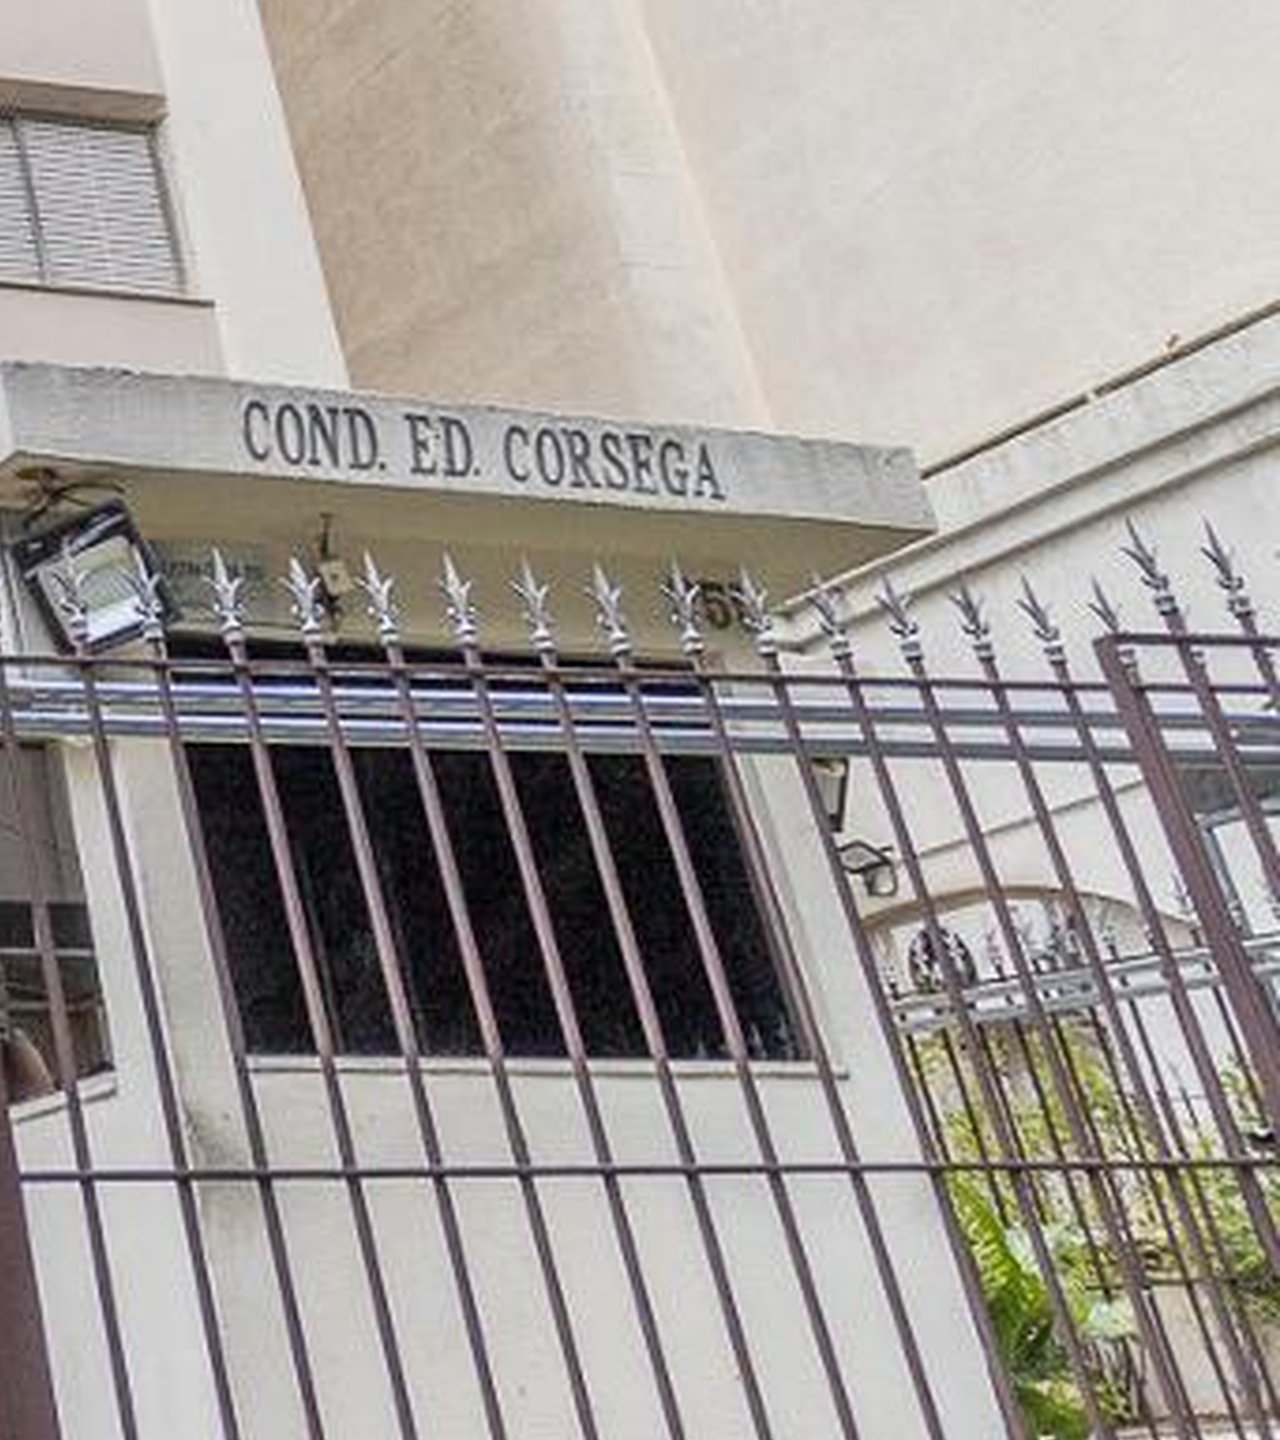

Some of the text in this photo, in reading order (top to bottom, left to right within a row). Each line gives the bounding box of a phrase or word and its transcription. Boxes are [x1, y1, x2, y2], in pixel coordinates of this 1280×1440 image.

[243, 400, 726, 501] COND. ED. CORSEGA
